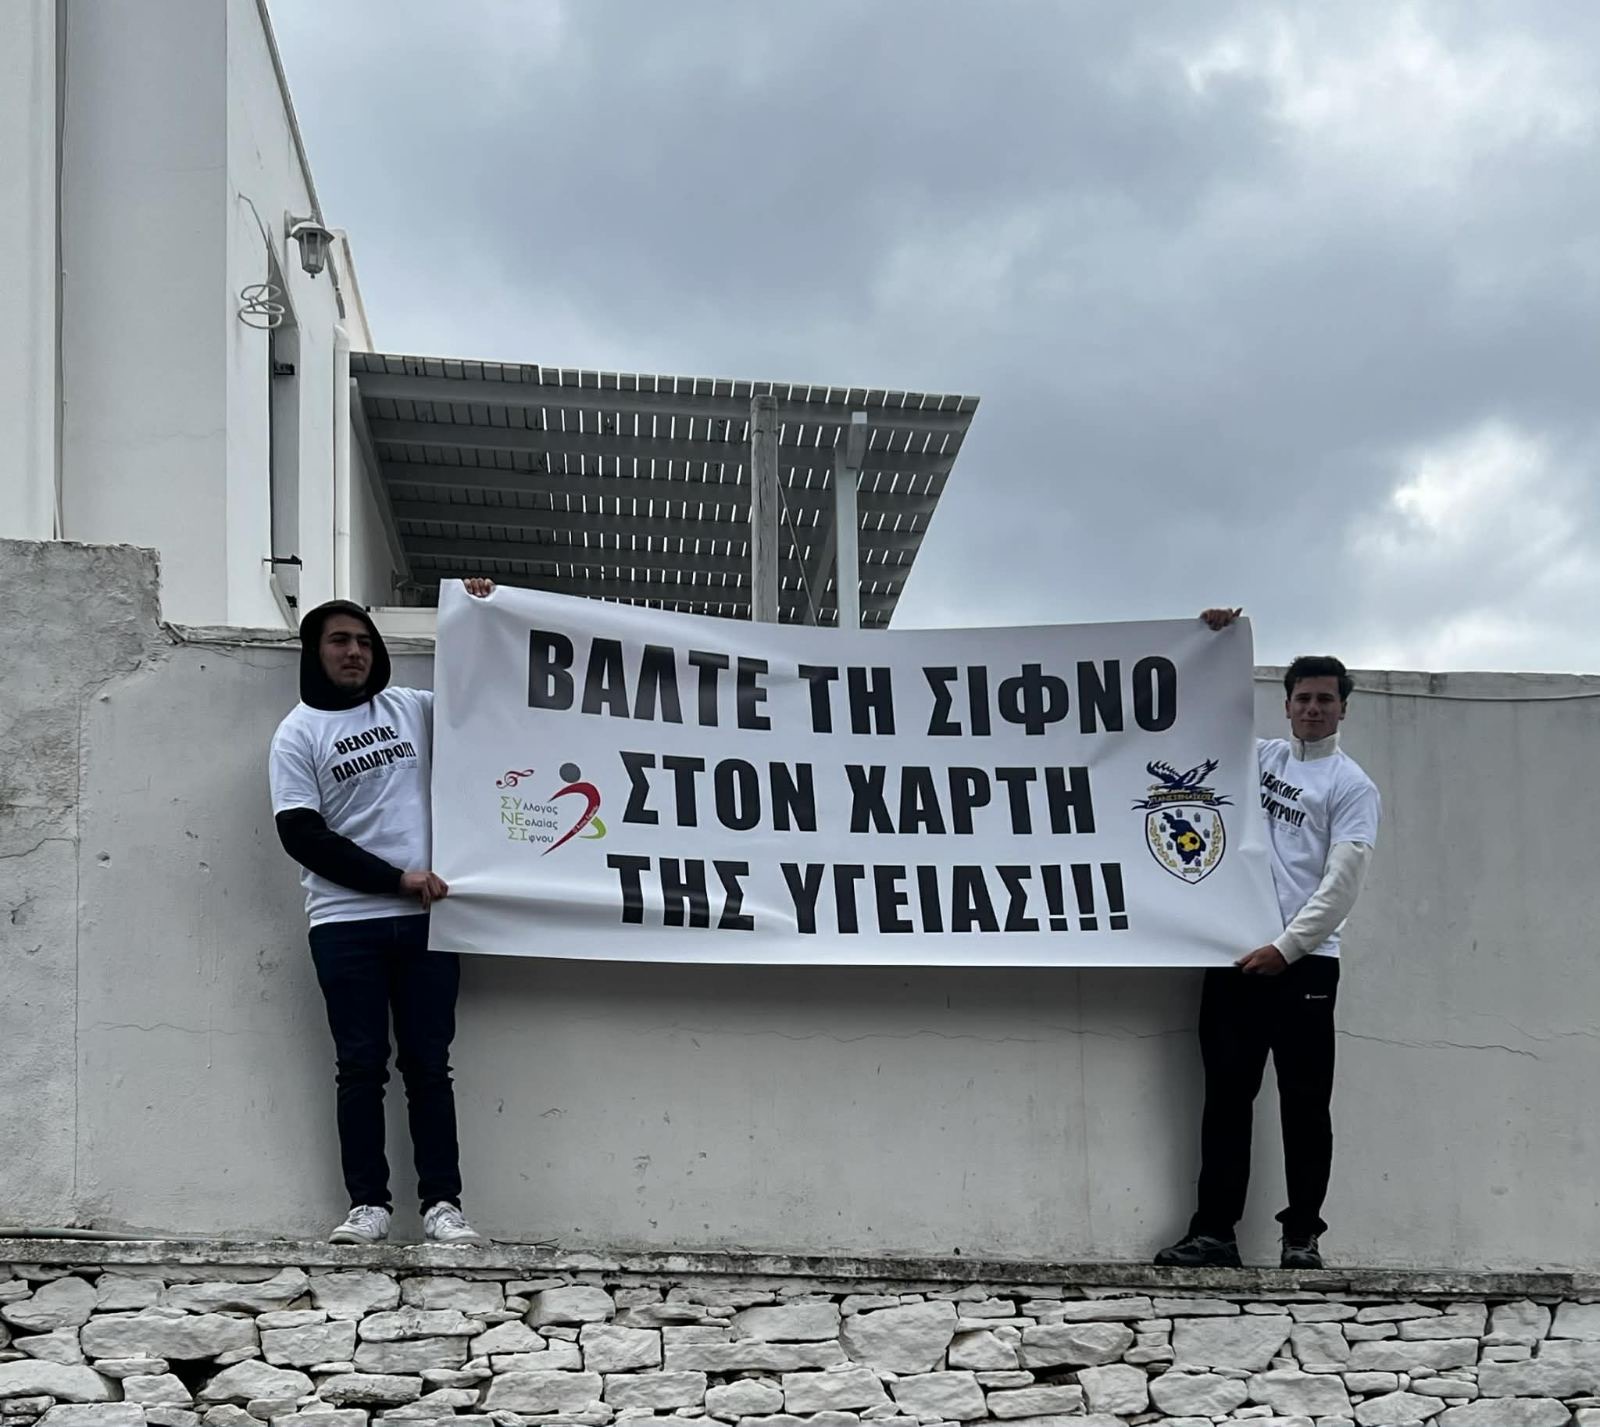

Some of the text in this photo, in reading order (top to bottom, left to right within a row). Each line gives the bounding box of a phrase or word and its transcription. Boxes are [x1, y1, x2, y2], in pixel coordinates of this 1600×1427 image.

[527, 629, 1178, 737] ΒΑΛΤΕ ΤΗ ΣΙΦΝΟ
[334, 725, 399, 755] ΘΕΛΟΥΜΕ
[619, 750, 1096, 835] ΣΤΟΝ ΧΑΡΤΗ
[606, 853, 1129, 935] ΤΗΣ ΥΓΕΙΑΣ!!!
